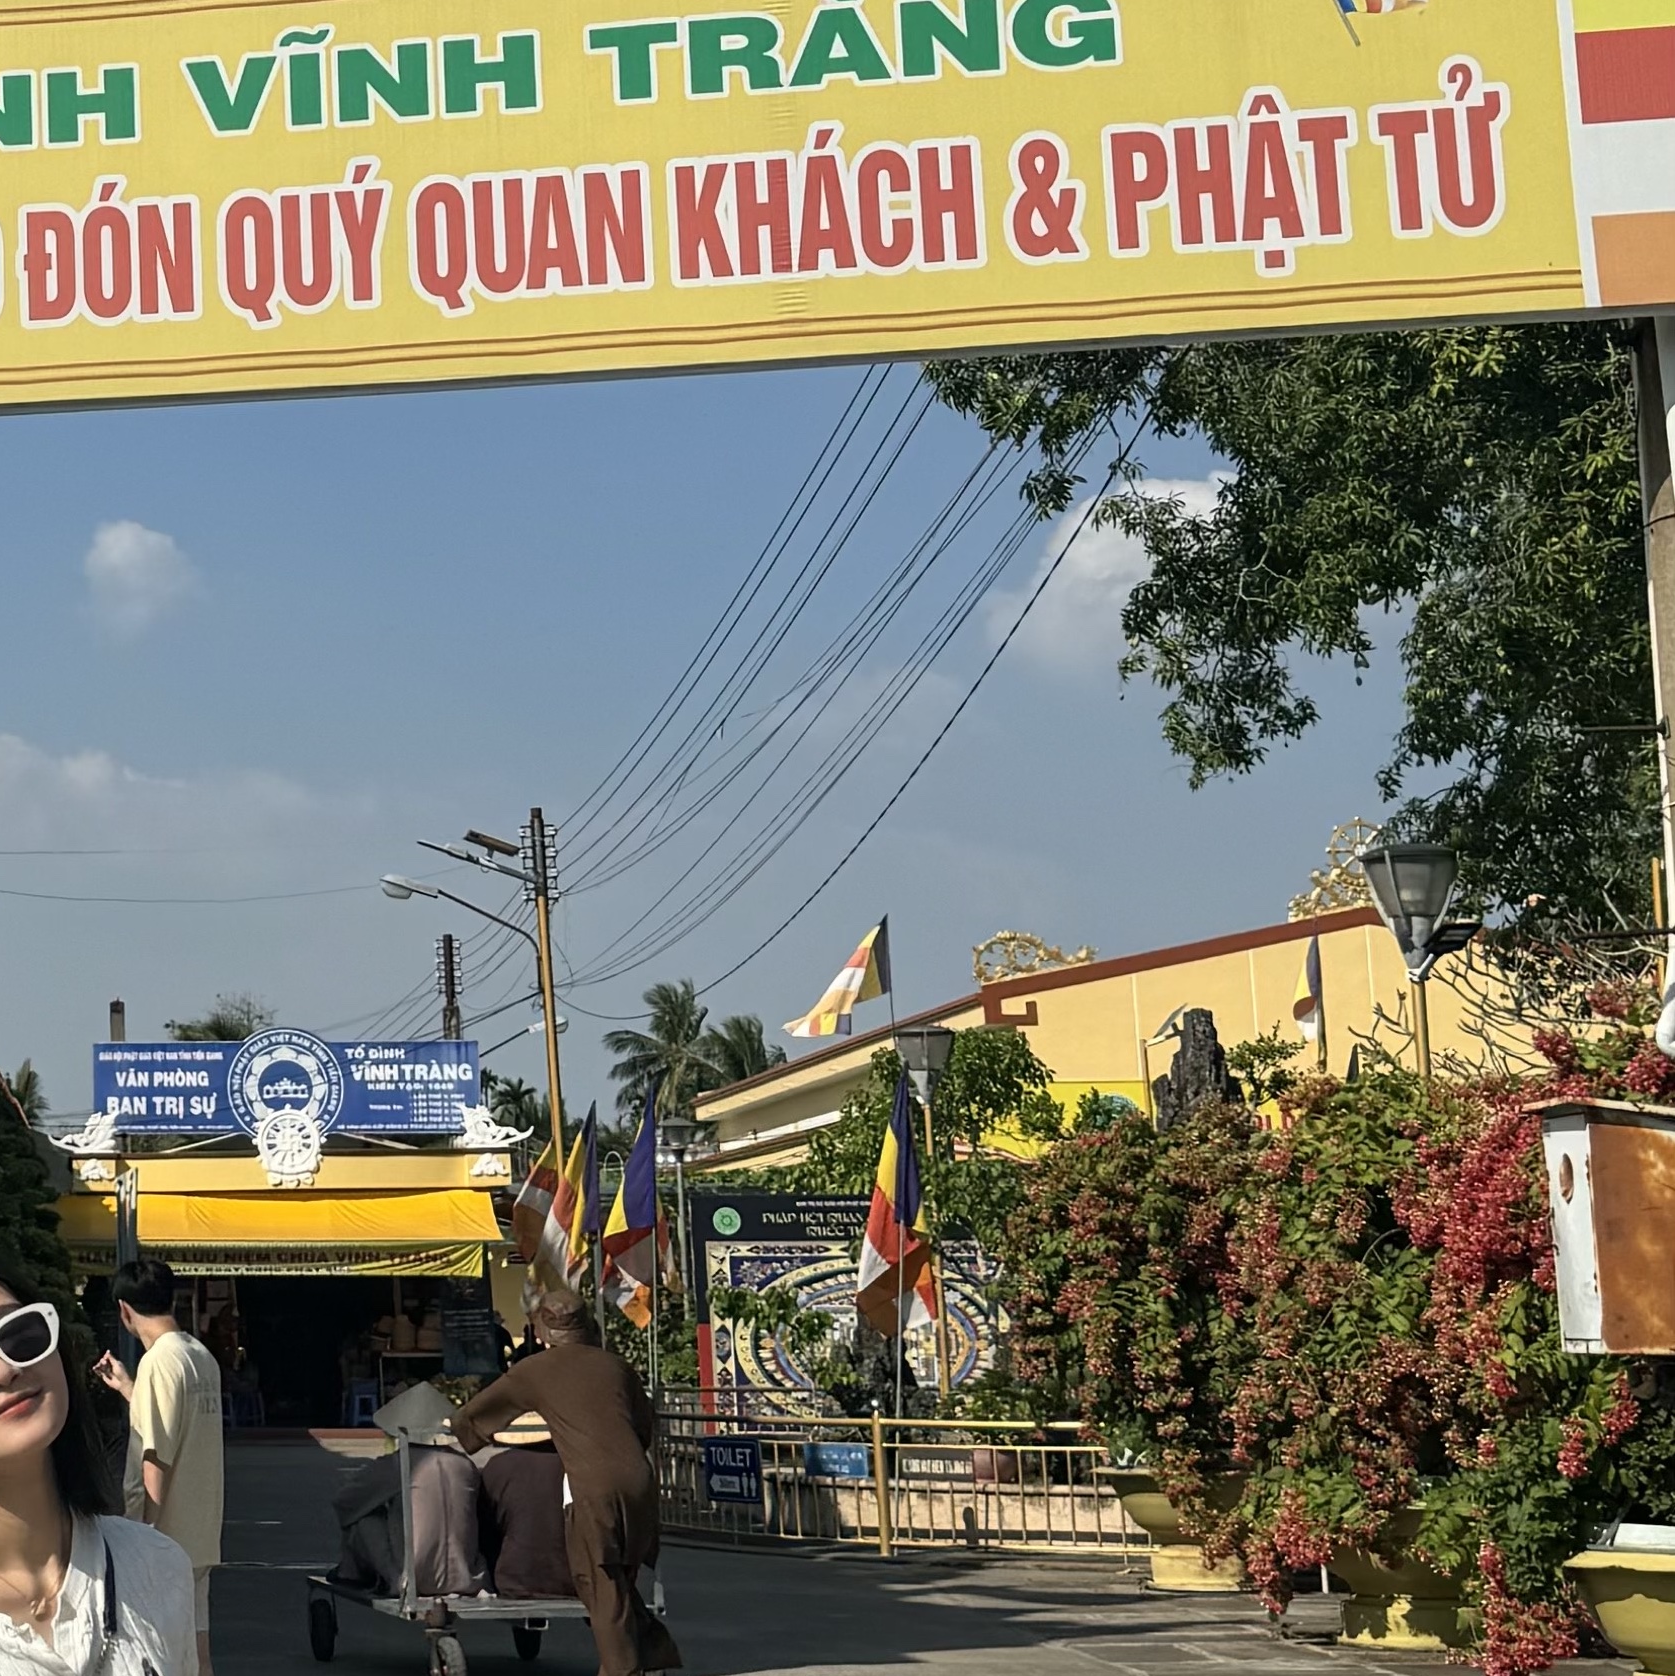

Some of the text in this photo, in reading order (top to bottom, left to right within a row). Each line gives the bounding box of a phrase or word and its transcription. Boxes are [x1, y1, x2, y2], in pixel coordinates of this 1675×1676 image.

[188, 30, 536, 130] VĨNH
[22, 182, 194, 321] ĐÓN
[225, 163, 386, 328] QUÝ
[416, 160, 645, 309] QUAN
[675, 130, 978, 280] KHÁCH
[1013, 139, 1078, 257] &
[1111, 93, 1348, 268] PHẬT
[1378, 62, 1500, 232] TỬ
[368, 1046, 406, 1059] ĐÌNH
[115, 1067, 209, 1087] VĂN PHÒNG
[350, 1059, 473, 1081] VĨNH TRÀNG
[107, 1092, 217, 1119] BAN TRỊ SỰ
[709, 1446, 752, 1467] TOILET
